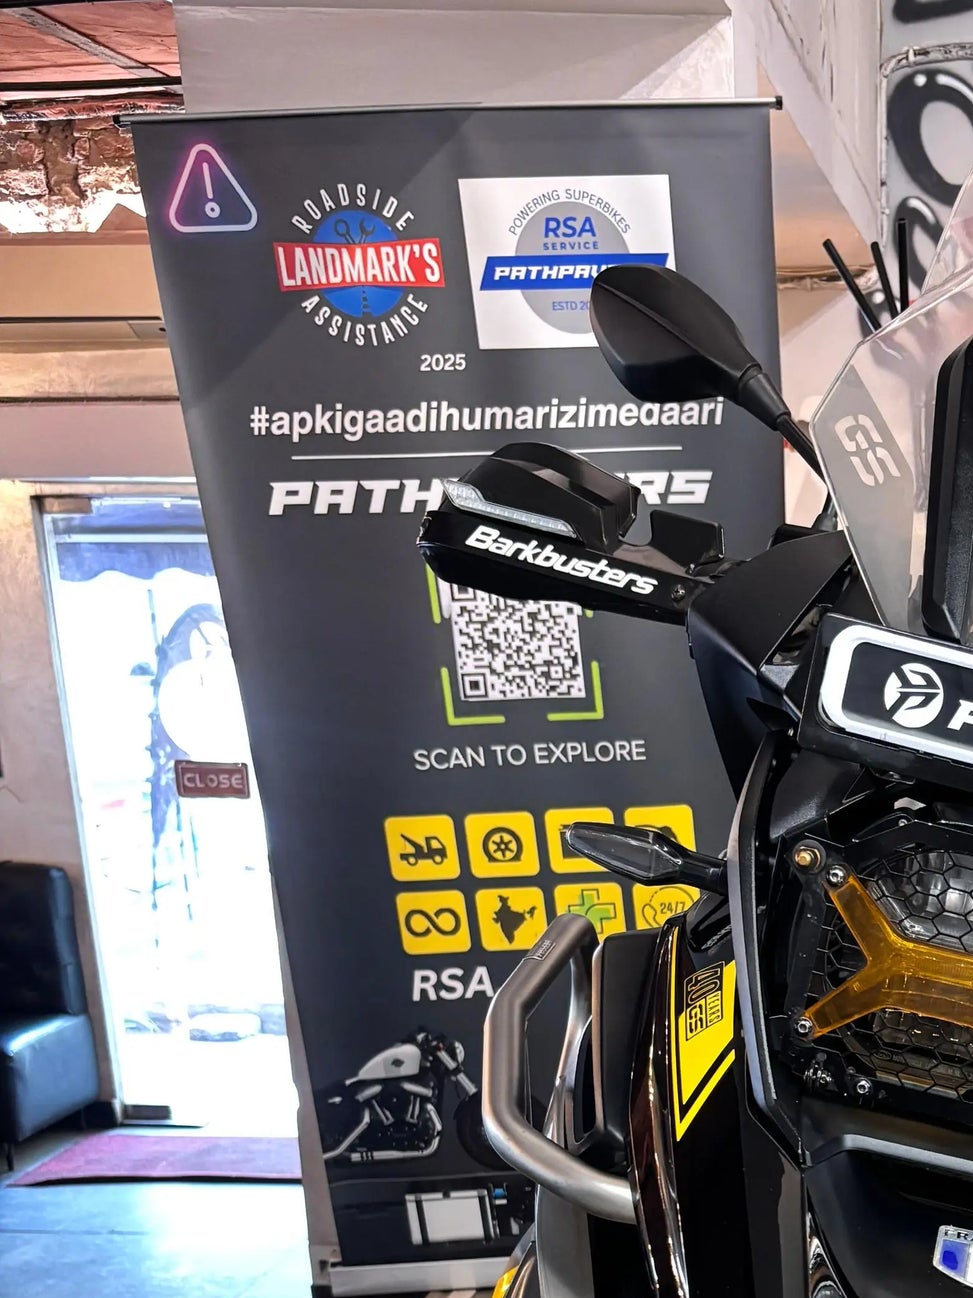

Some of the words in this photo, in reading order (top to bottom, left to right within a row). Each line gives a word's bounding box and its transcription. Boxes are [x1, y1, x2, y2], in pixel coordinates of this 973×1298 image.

[291, 183, 414, 234] ROADSIDE
[508, 189, 561, 236] POWERING
[564, 188, 632, 235] SUPERBIKES
[542, 241, 600, 251] SERVICE
[543, 216, 597, 239] RSA
[277, 242, 441, 287] LANDMARK'S
[301, 293, 428, 346] ASSISTANCE
[552, 300, 578, 312] ESTD
[420, 353, 466, 372] 2025
[834, 414, 901, 487] GS
[268, 470, 713, 516] PATHRS
[465, 524, 659, 595] Barkbusters
[412, 746, 486, 771] SCAN
[491, 744, 527, 766] TO
[533, 740, 647, 765] EXPLORE
[183, 773, 243, 789] CLOSE
[660, 901, 686, 915] 24/7
[412, 965, 494, 1002] RSA
